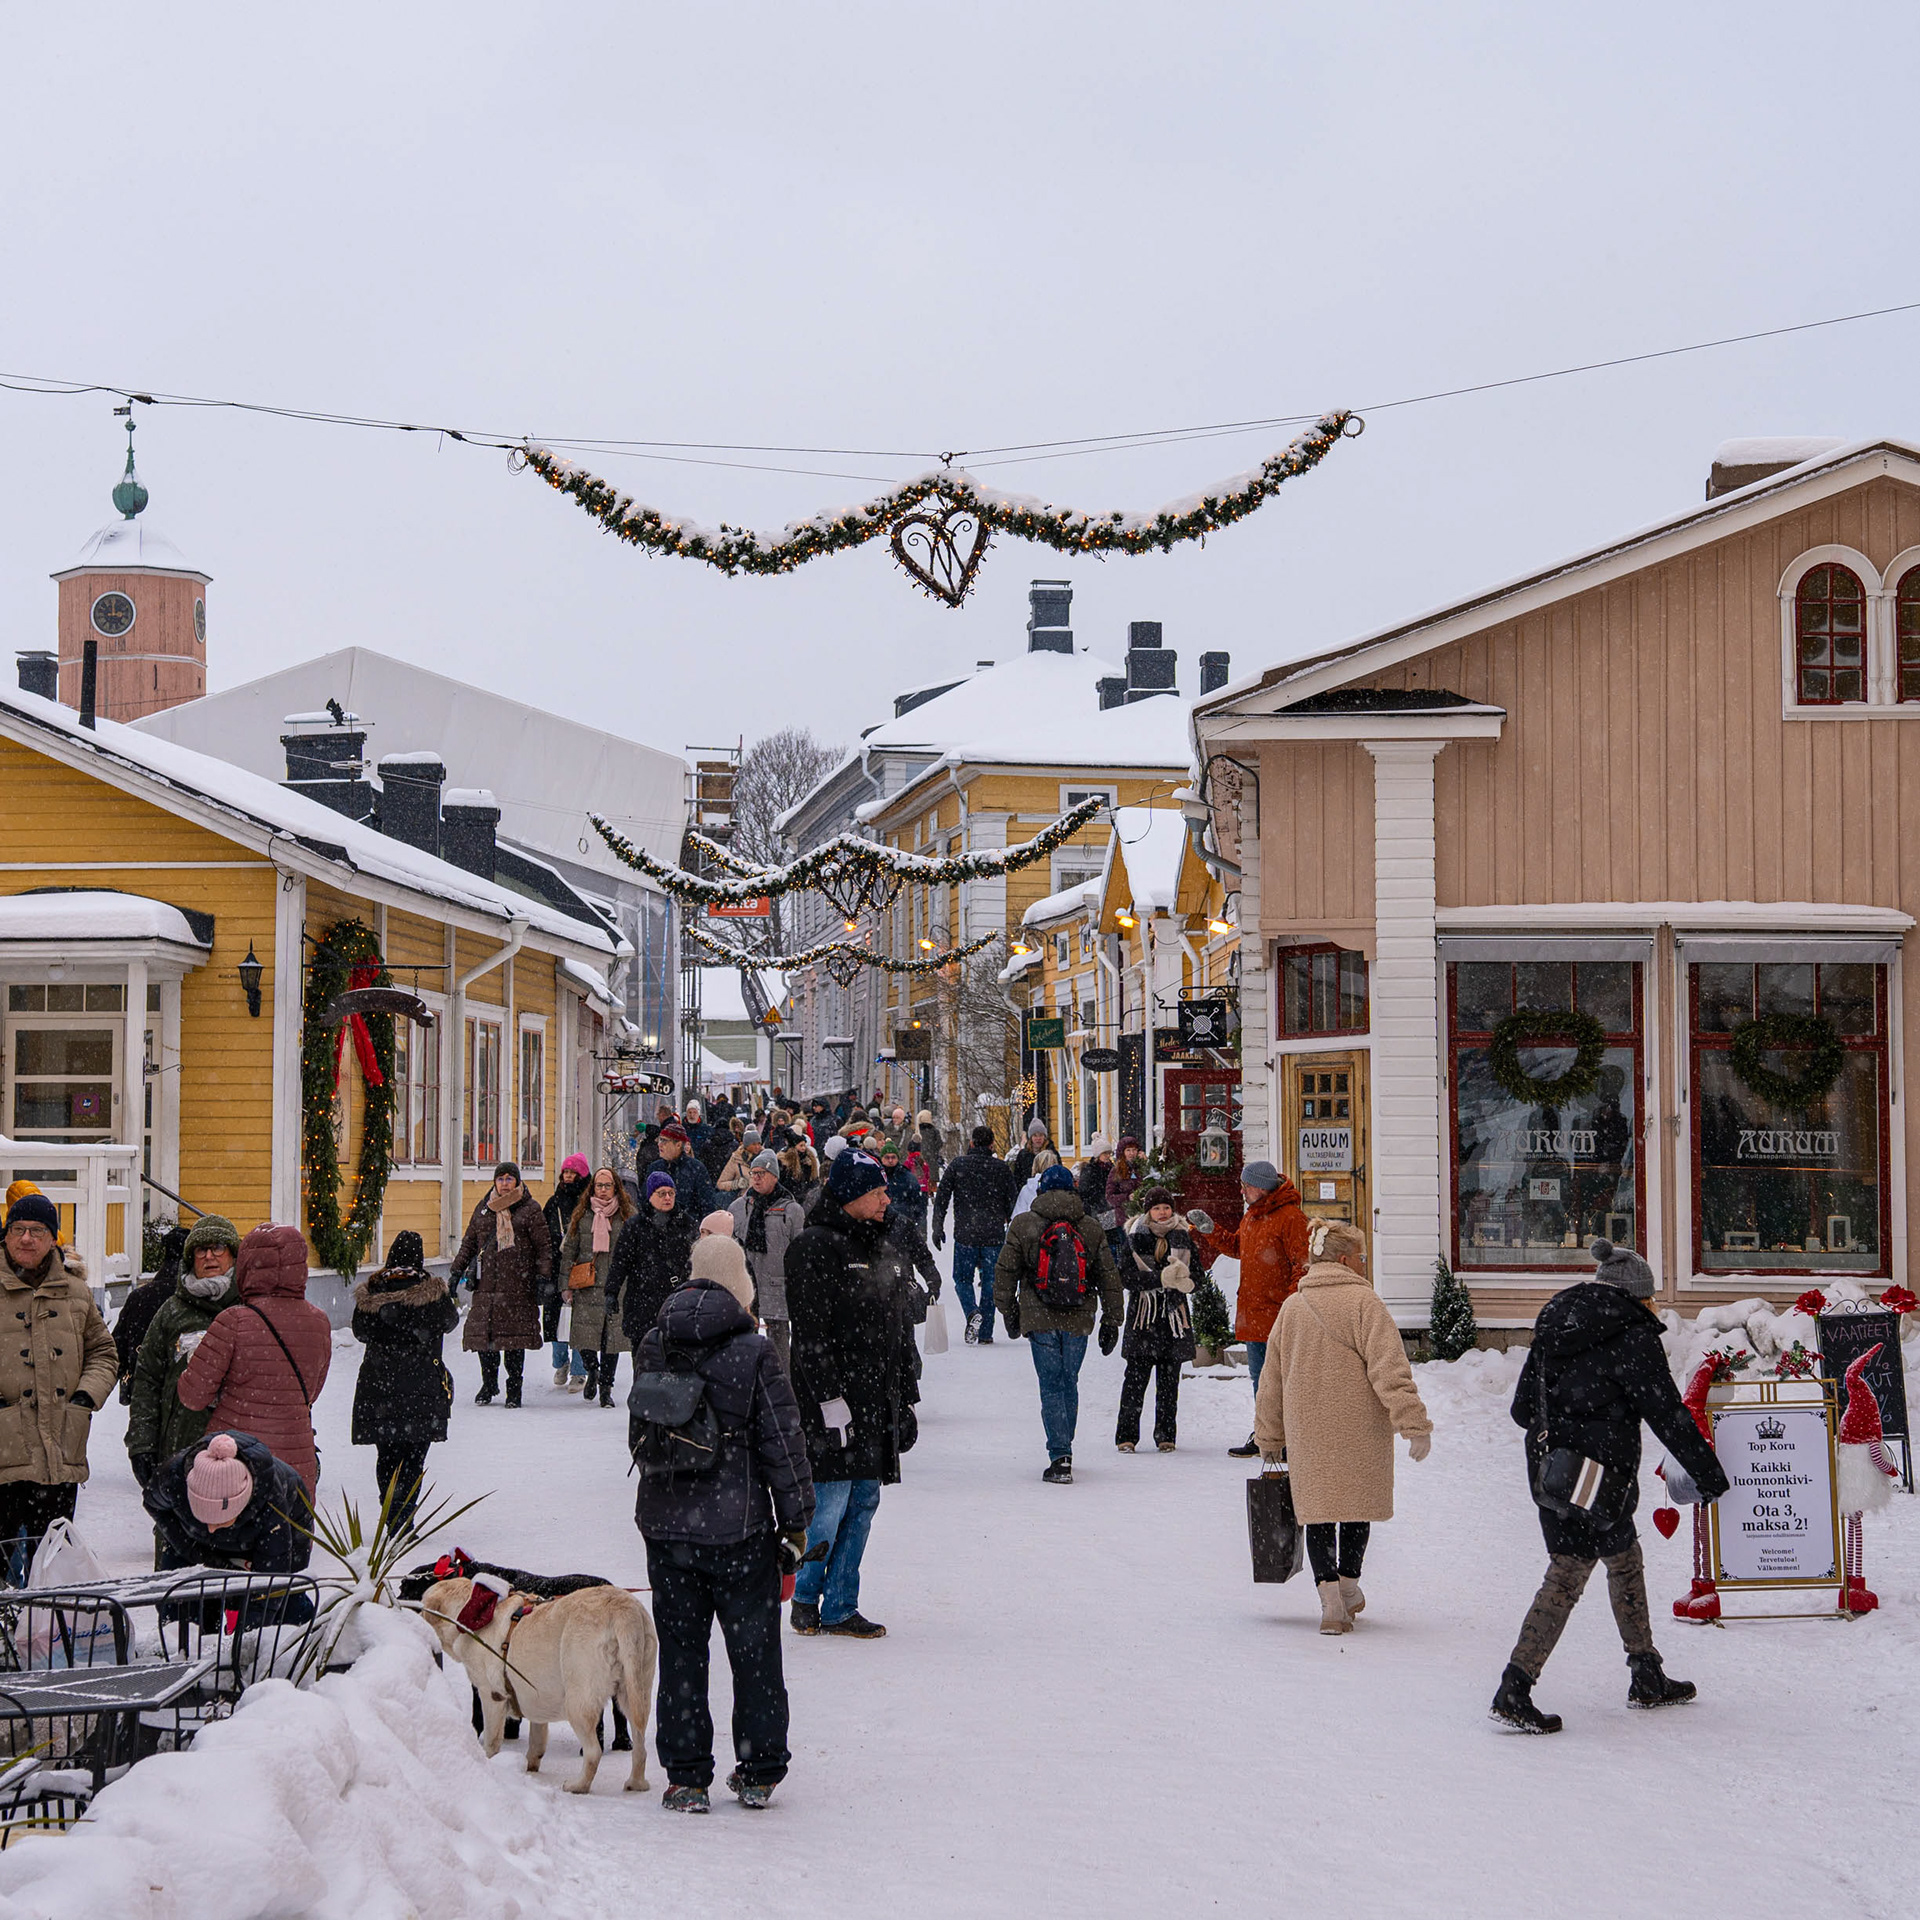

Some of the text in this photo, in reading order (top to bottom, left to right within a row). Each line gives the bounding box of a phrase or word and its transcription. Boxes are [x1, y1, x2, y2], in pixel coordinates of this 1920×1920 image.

[1302, 1132, 1349, 1149] AURUM
[1737, 1129, 1841, 1159] AURUM
[1827, 1322, 1891, 1342] VAATTEET
[1830, 1372, 1893, 1391] LKUT
[1748, 1441, 1796, 1453] Top Koru
[1751, 1462, 1791, 1473] Kaikki
[1734, 1475, 1813, 1486] luonnonkivi-
[1757, 1488, 1791, 1499] korut
[1752, 1504, 1797, 1518] Ota 3,
[1742, 1518, 1808, 1531] maksa 2!
